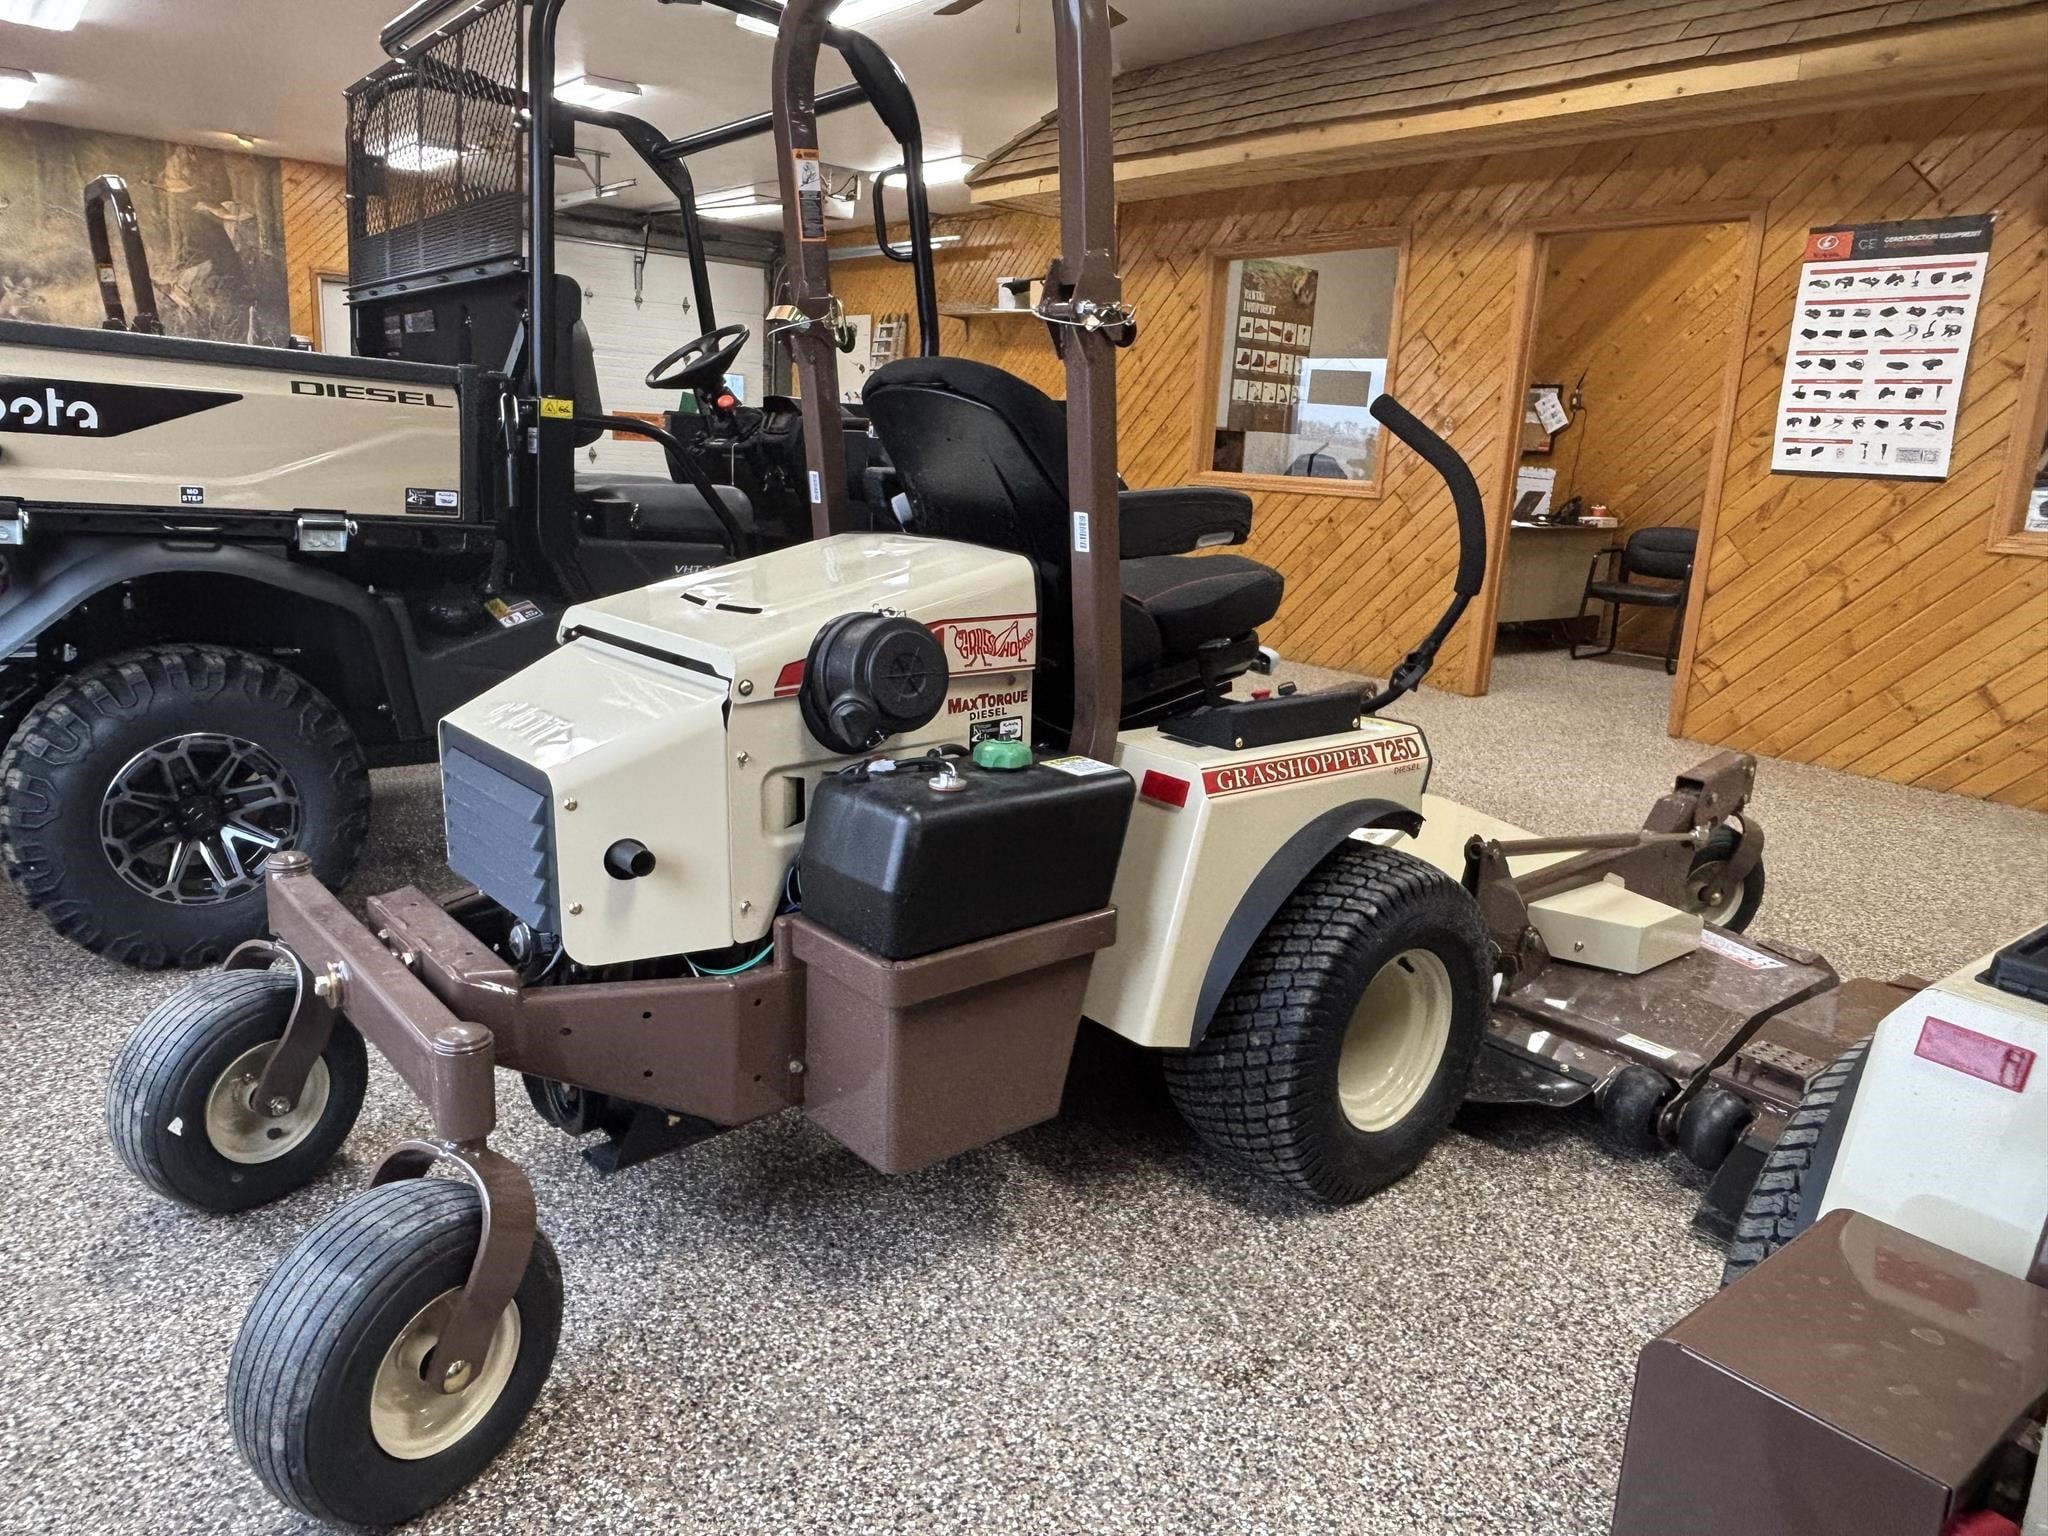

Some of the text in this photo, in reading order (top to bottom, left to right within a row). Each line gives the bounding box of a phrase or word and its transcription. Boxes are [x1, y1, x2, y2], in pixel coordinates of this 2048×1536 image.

[290, 381, 454, 409] DIESEL
[0, 387, 98, 429] ota
[181, 494, 203, 502] STEP
[969, 707, 1008, 721] DIESEL
[1216, 736, 1421, 791] GRASSHOPPER 725D
[1393, 762, 1422, 776] DIESEL
